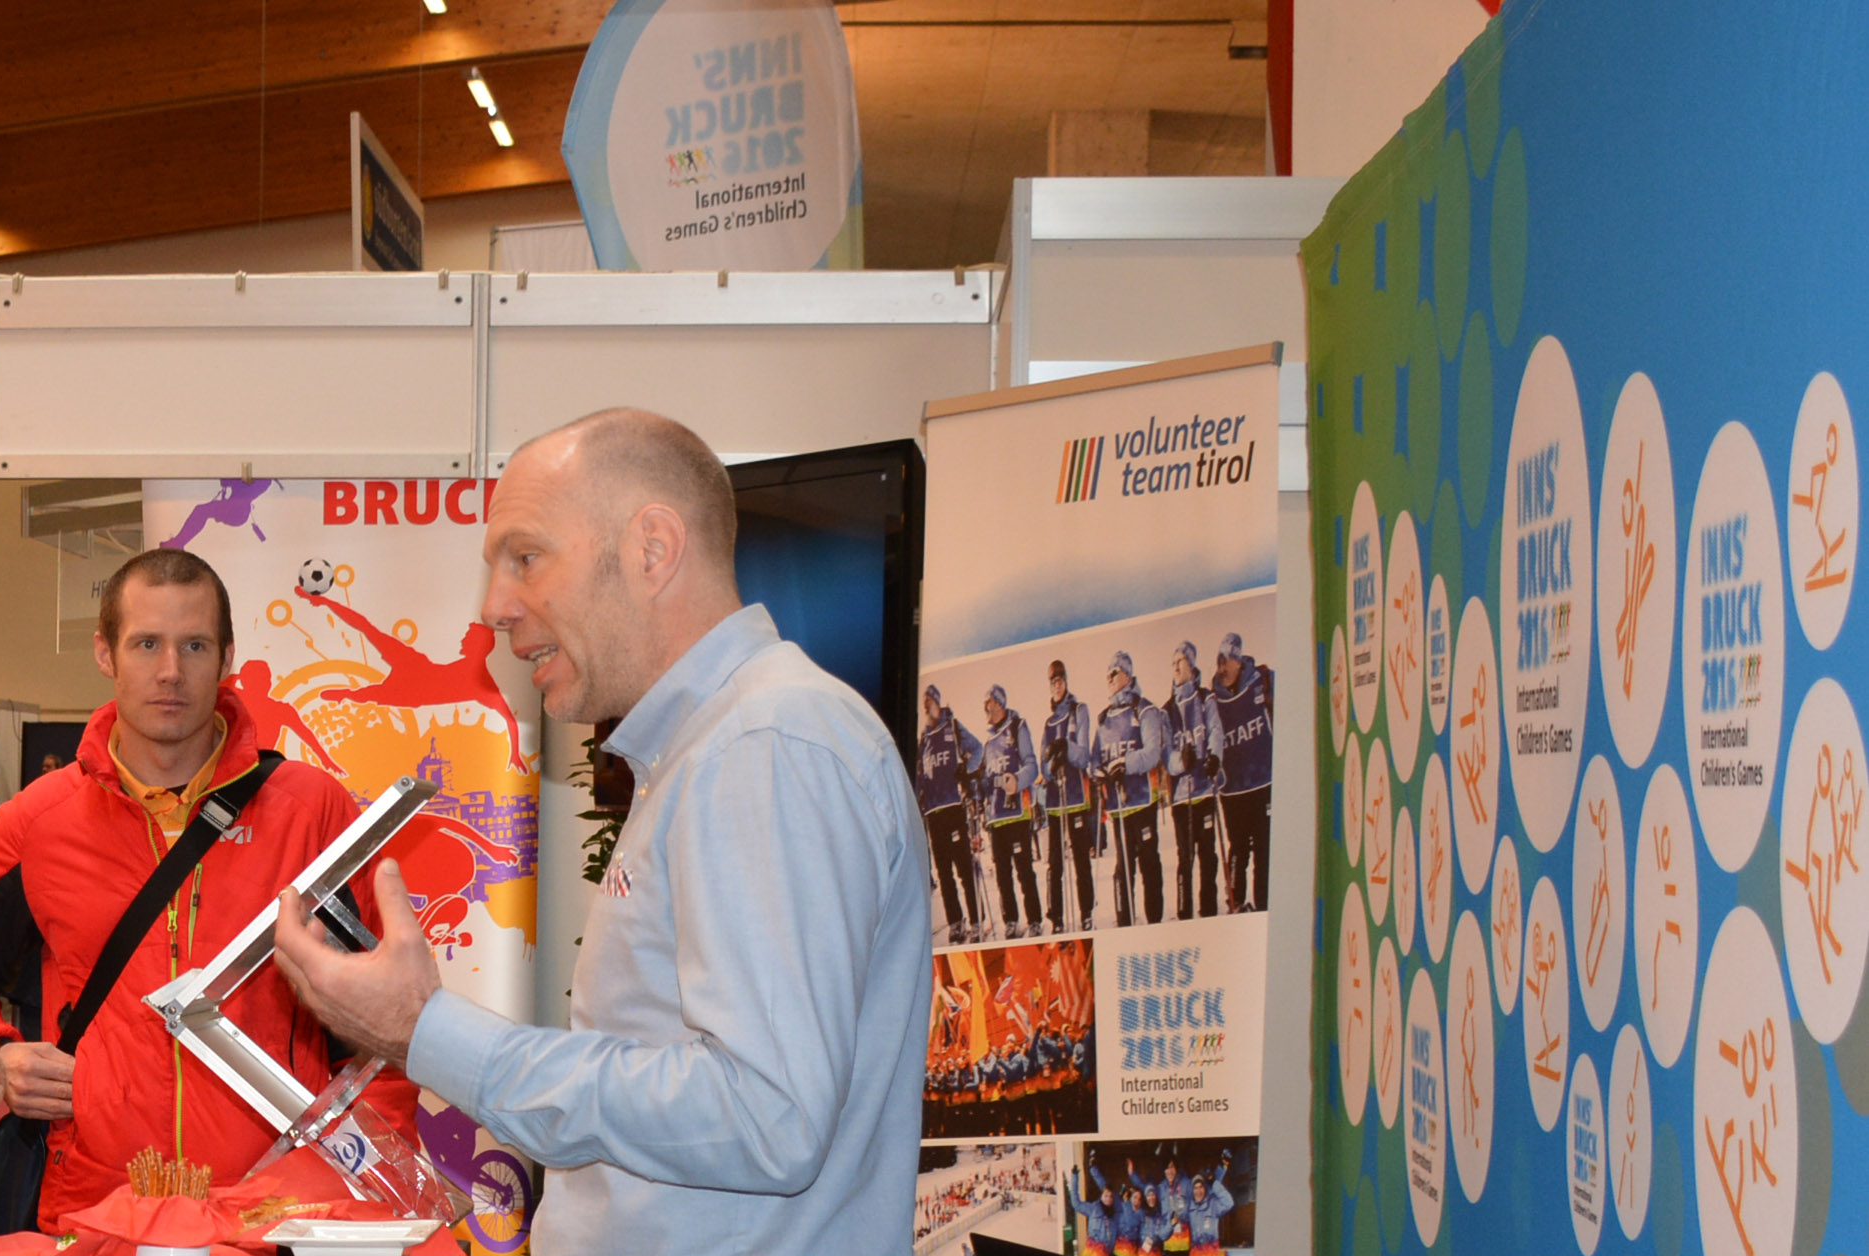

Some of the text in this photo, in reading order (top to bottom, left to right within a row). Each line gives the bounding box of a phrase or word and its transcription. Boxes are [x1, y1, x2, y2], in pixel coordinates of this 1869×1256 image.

[1114, 414, 1247, 460] volunteer
[1517, 518, 1572, 604] BRUCK
[1701, 580, 1762, 654] BRUCK
[1701, 718, 1748, 749] International
[1737, 760, 1763, 787] Games
[1118, 946, 1202, 992] INNS'
[1119, 988, 1226, 1033] BRUCK
[1120, 1035, 1186, 1071] 2016
[1120, 1073, 1204, 1094] International
[1121, 1094, 1229, 1116] Children's Games
